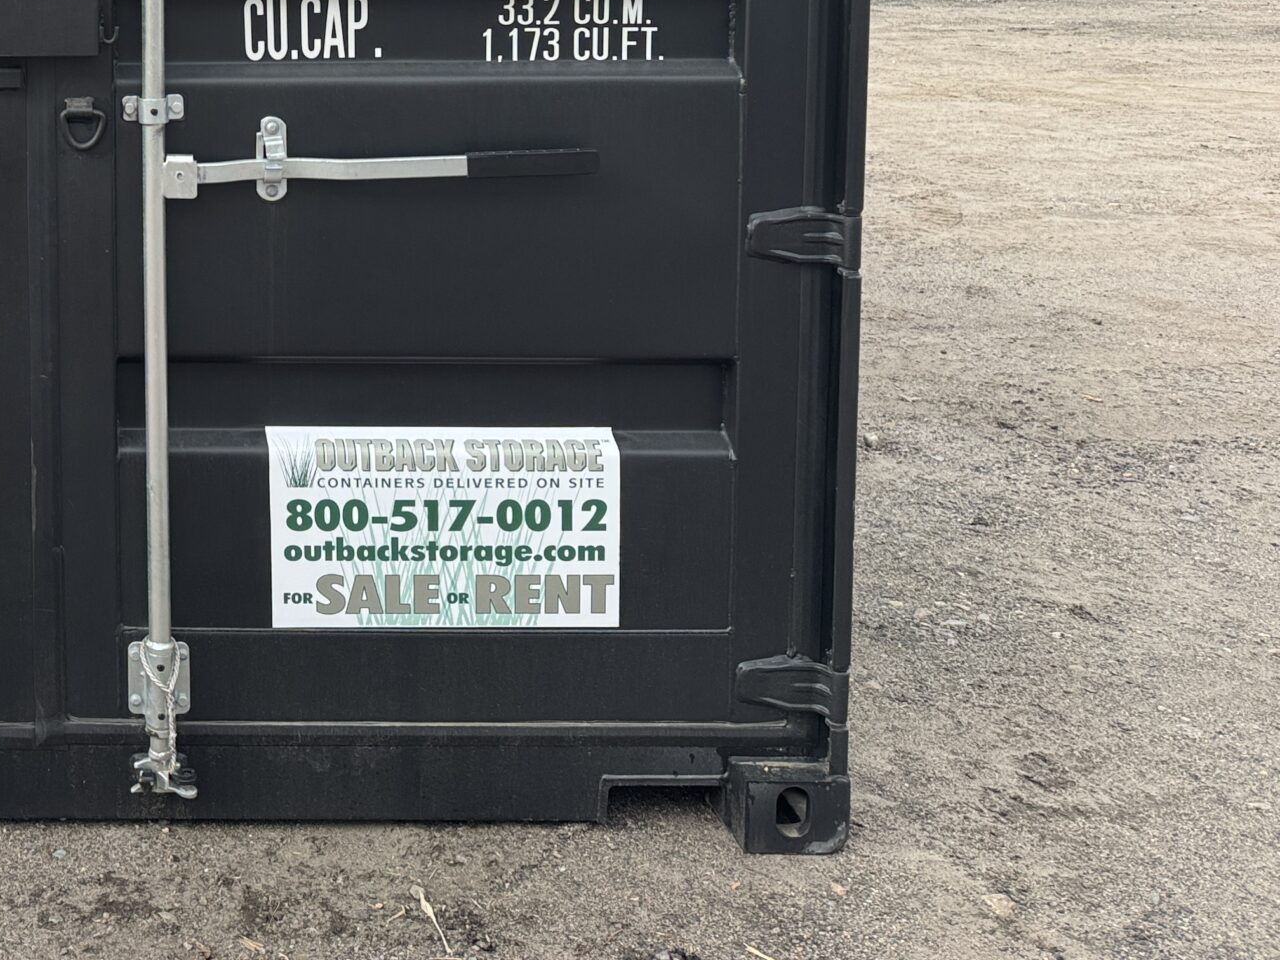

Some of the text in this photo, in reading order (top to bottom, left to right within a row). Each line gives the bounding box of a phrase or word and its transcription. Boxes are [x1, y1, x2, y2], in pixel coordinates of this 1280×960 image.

[482, 27, 665, 63] 1,173 CU.FT.
[314, 438, 460, 473] OUTBACK
[464, 438, 605, 473] STORAGE
[317, 477, 605, 489] CONTAINERS DELIVERED ON SITE
[285, 499, 607, 532] 800-517-0012
[283, 537, 606, 567] outbackstorage.com
[283, 574, 615, 615] FOR SALE OR RENT
